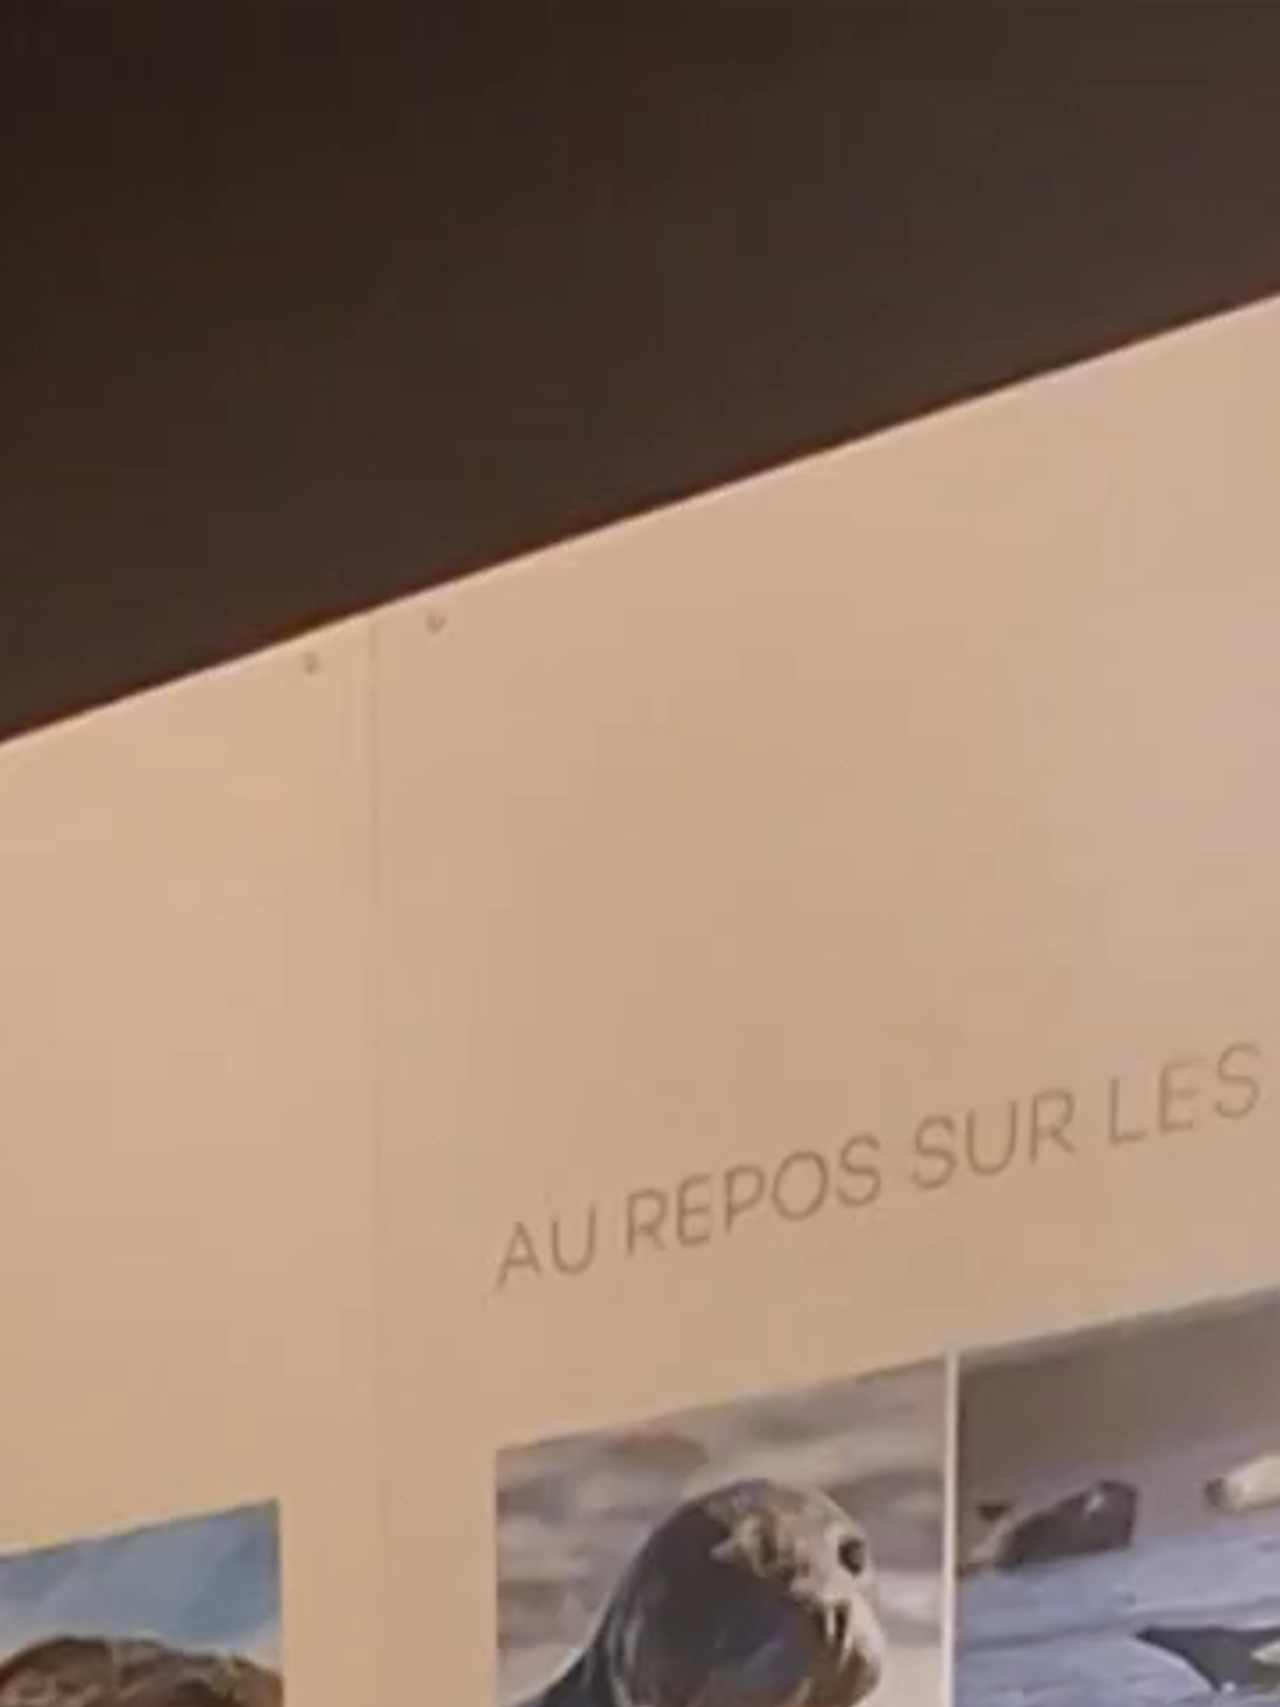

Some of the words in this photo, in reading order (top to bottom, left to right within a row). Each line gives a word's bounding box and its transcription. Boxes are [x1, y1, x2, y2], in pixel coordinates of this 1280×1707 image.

[495, 1200, 597, 1293] AU
[625, 1130, 882, 1258] REPOS
[908, 1088, 1080, 1192] SUR
[1108, 1040, 1262, 1146] LES
